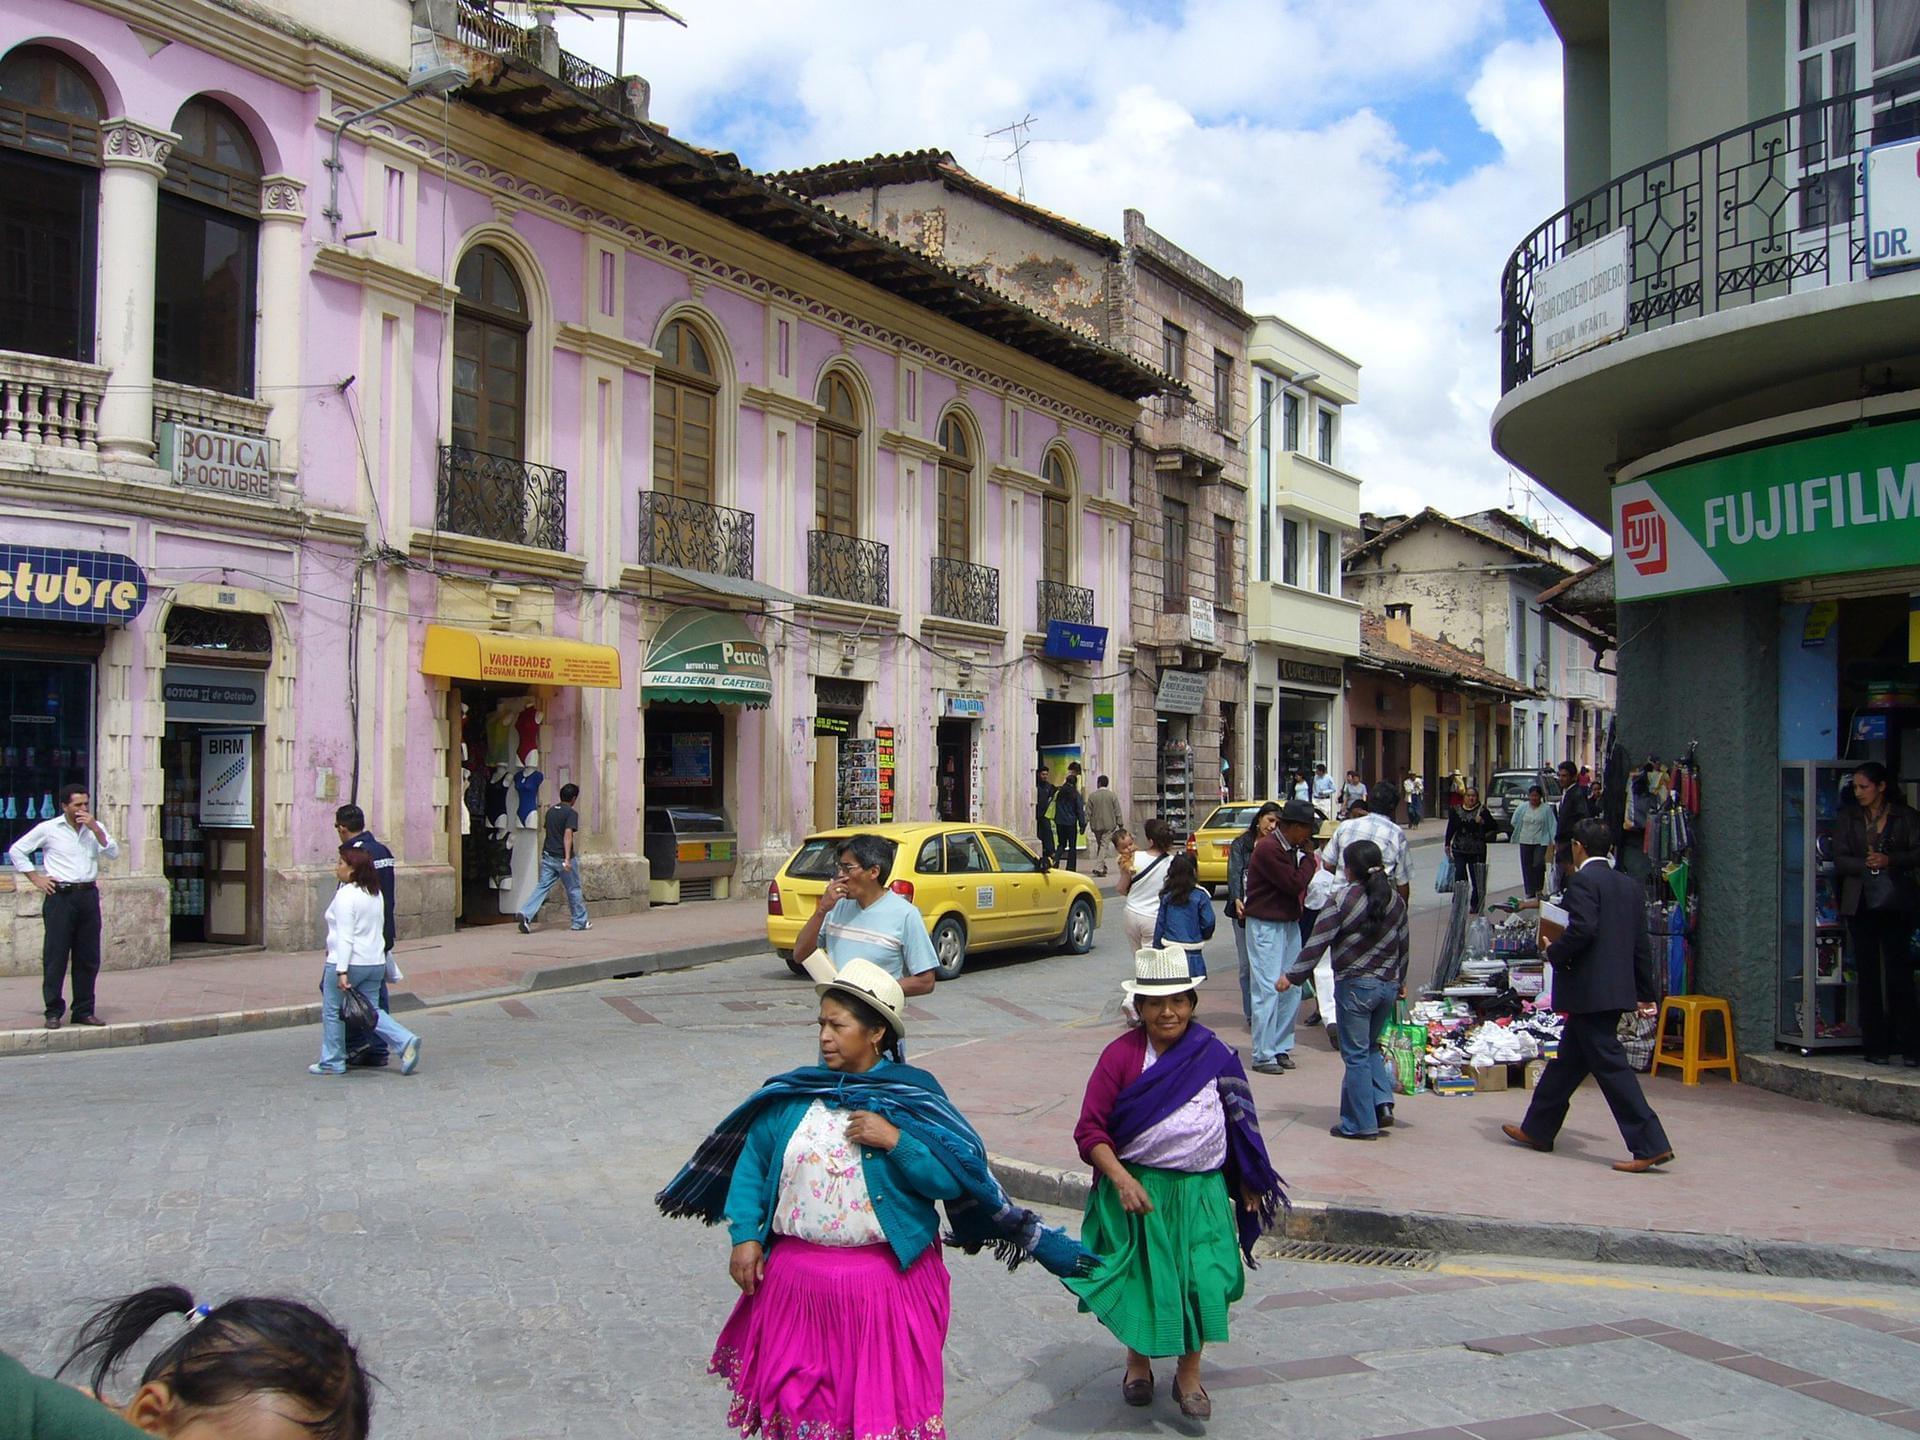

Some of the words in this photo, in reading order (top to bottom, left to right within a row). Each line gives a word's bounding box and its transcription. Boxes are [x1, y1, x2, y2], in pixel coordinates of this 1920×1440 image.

[1874, 228, 1911, 259] DR.
[1546, 325, 1576, 352] MEDICINA
[1577, 311, 1609, 337] INFANTIL
[180, 430, 268, 472] BOTICA
[198, 464, 268, 495] OCTUBRE
[1704, 461, 1920, 548] FUJIFILM
[1622, 504, 1665, 566] FUJI
[1192, 610, 1213, 622] DENTAL
[483, 666, 517, 677] GEOVANA
[518, 669, 554, 680] ESTEFANIA
[489, 653, 552, 669] VARIEDADES
[651, 674, 716, 686] HELADERIA
[721, 677, 766, 689] CAFETERIA
[208, 739, 244, 755] BIRM
